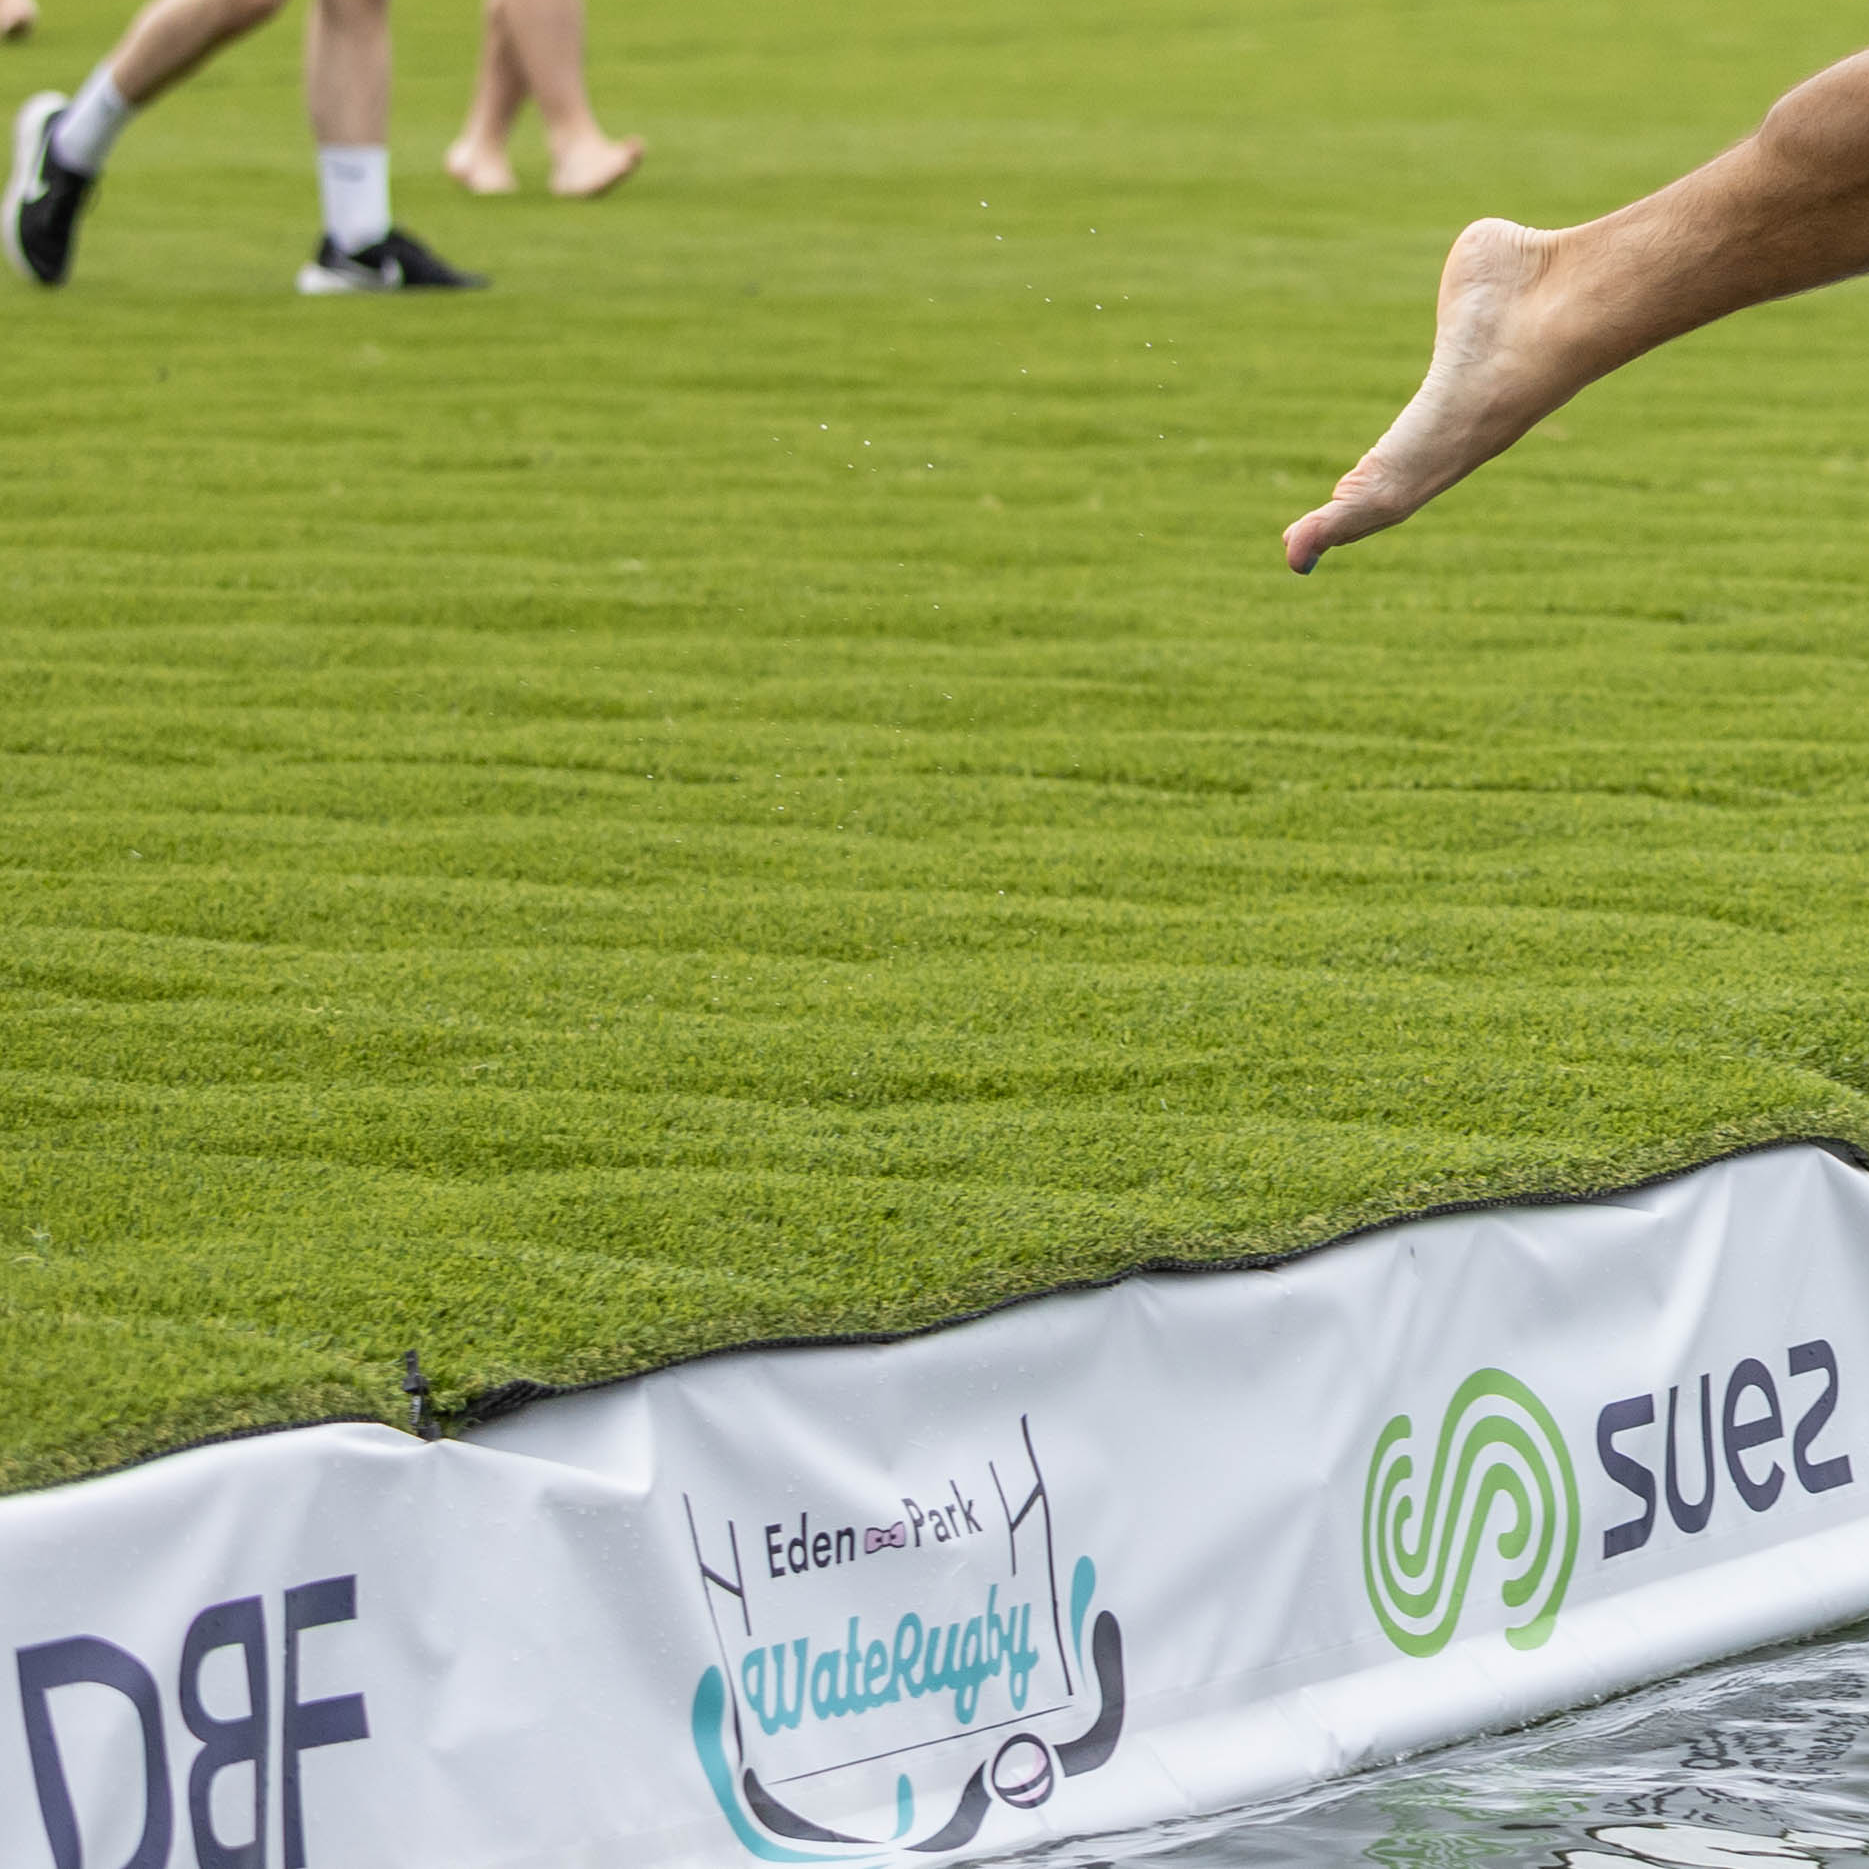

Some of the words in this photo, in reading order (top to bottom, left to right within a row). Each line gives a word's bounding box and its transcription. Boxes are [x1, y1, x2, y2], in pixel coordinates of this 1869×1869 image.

[1598, 1338, 1852, 1559] suez
[764, 1511, 856, 1579] Eden
[901, 1479, 984, 1548] Park
[741, 1583, 1041, 1736] WateRugby
